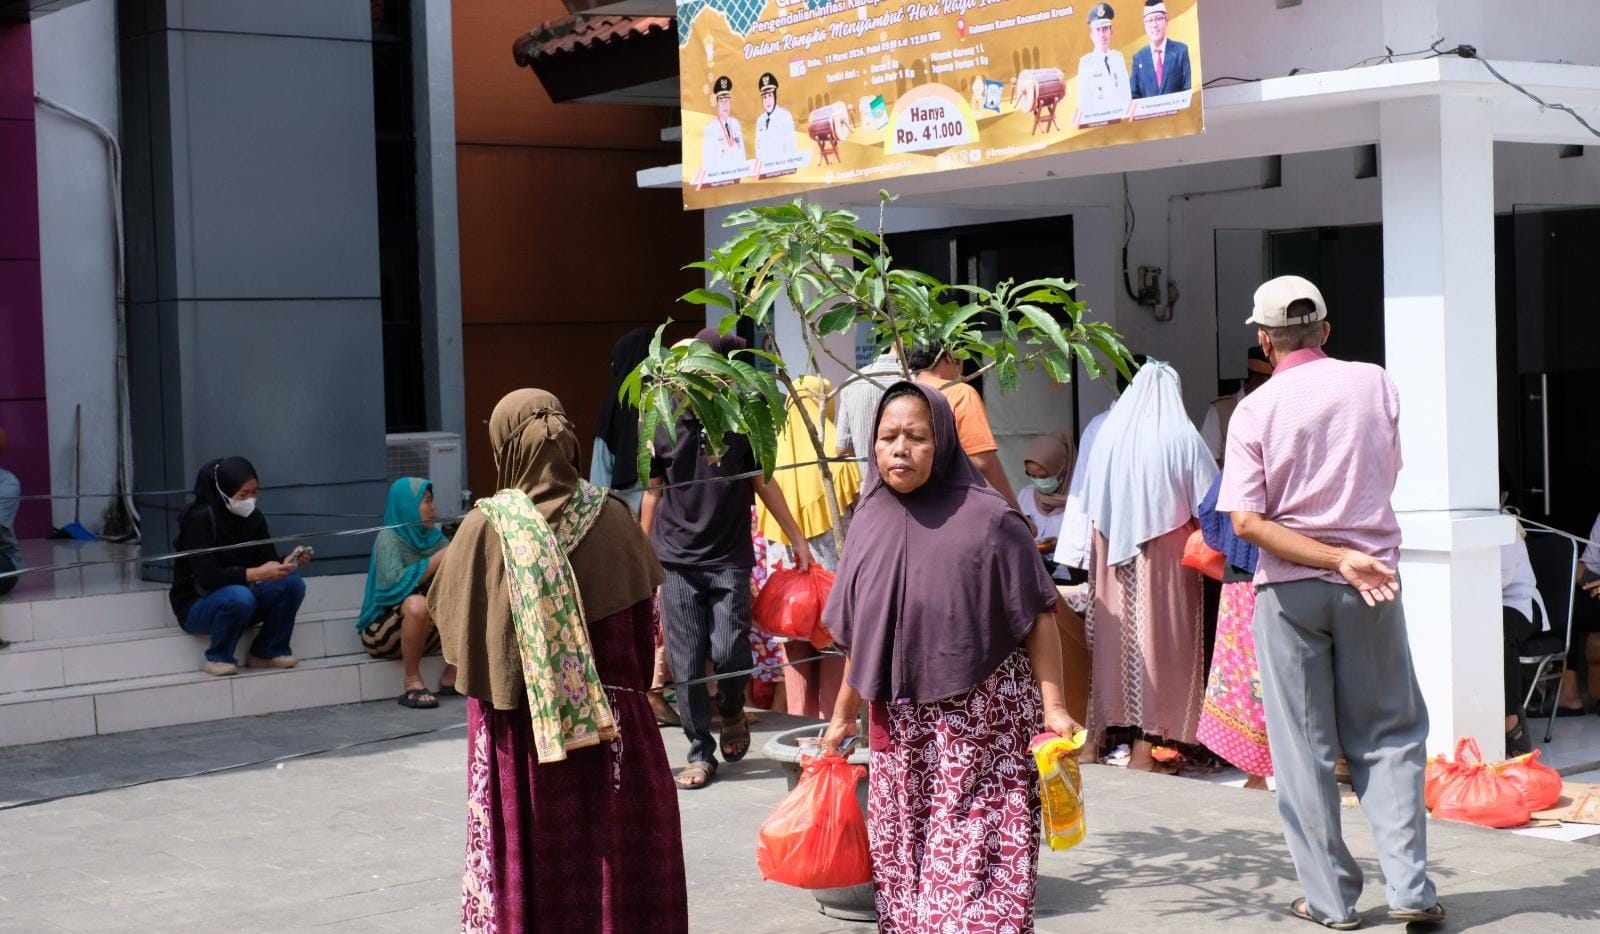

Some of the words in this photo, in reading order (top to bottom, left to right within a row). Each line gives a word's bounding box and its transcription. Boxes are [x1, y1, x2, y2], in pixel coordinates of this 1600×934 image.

[752, 9, 817, 32] Pengendalian
[817, 2, 846, 17] Inflasi
[743, 39, 780, 59] Dalam
[783, 27, 828, 49] Rangka
[829, 7, 905, 38] Menyambut
[907, 4, 940, 21] Hari
[910, 107, 945, 122] Hanya
[896, 129, 917, 145] Rp.
